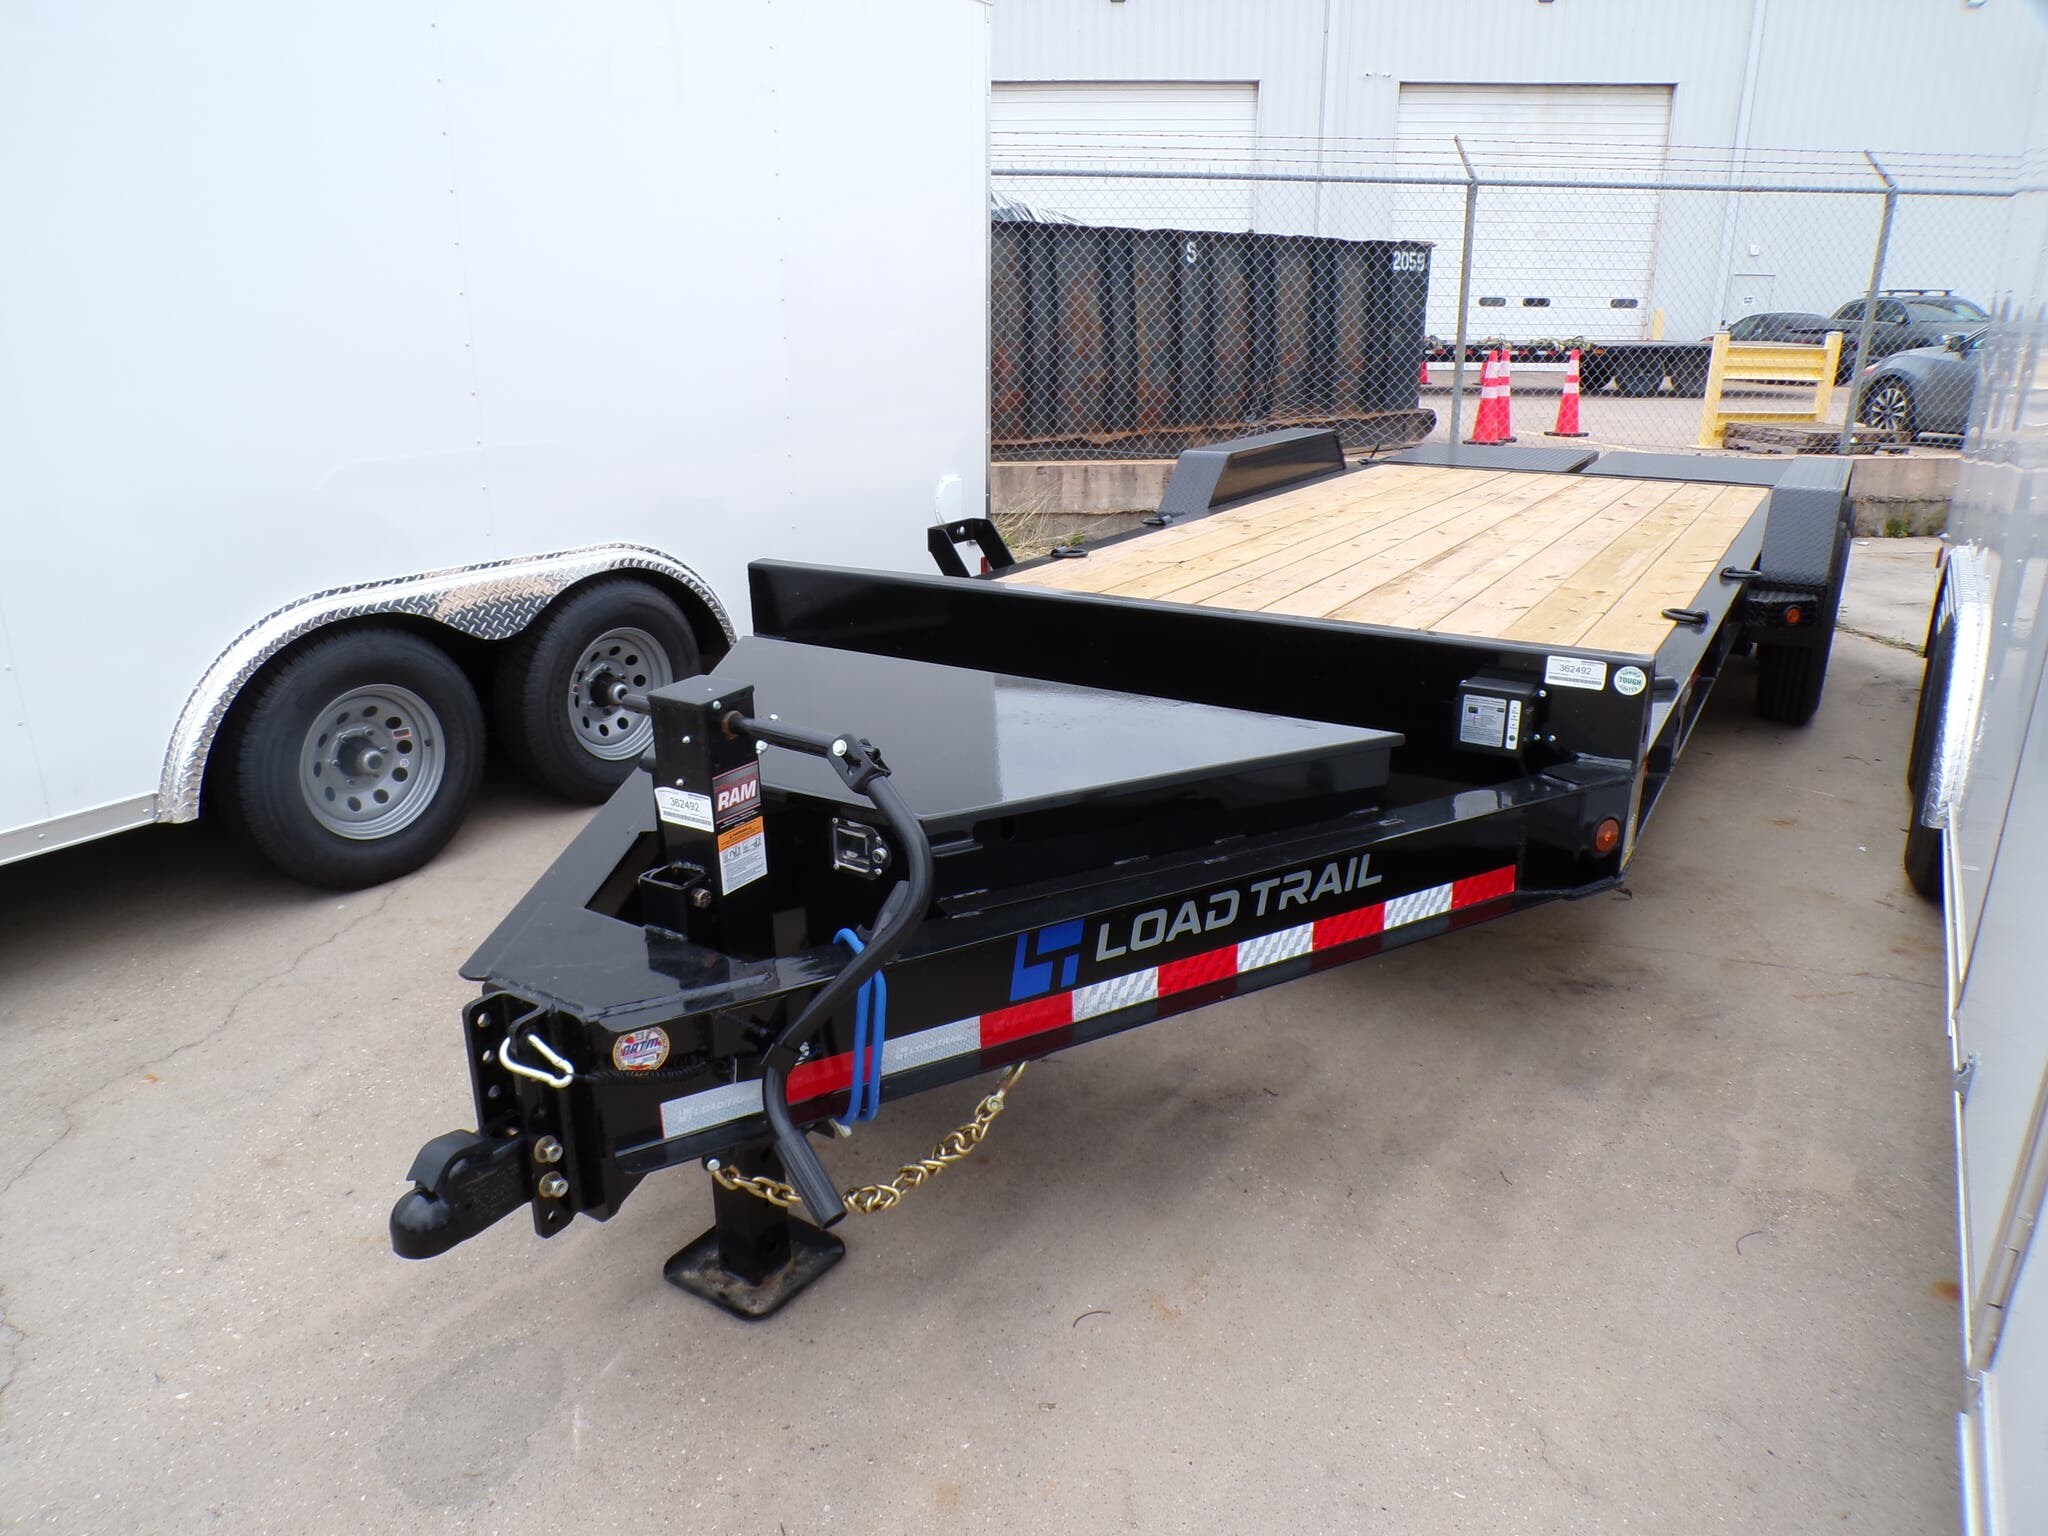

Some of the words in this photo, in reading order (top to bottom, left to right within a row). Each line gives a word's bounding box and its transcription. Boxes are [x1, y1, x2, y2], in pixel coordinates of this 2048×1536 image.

[1186, 241, 1197, 263] S
[1392, 250, 1426, 271] 2059
[1559, 664, 1592, 675] 362492
[669, 797, 700, 812] 362492
[717, 779, 757, 812] RAM
[1095, 888, 1241, 962] LOAD
[1250, 853, 1383, 917] TRAIL
